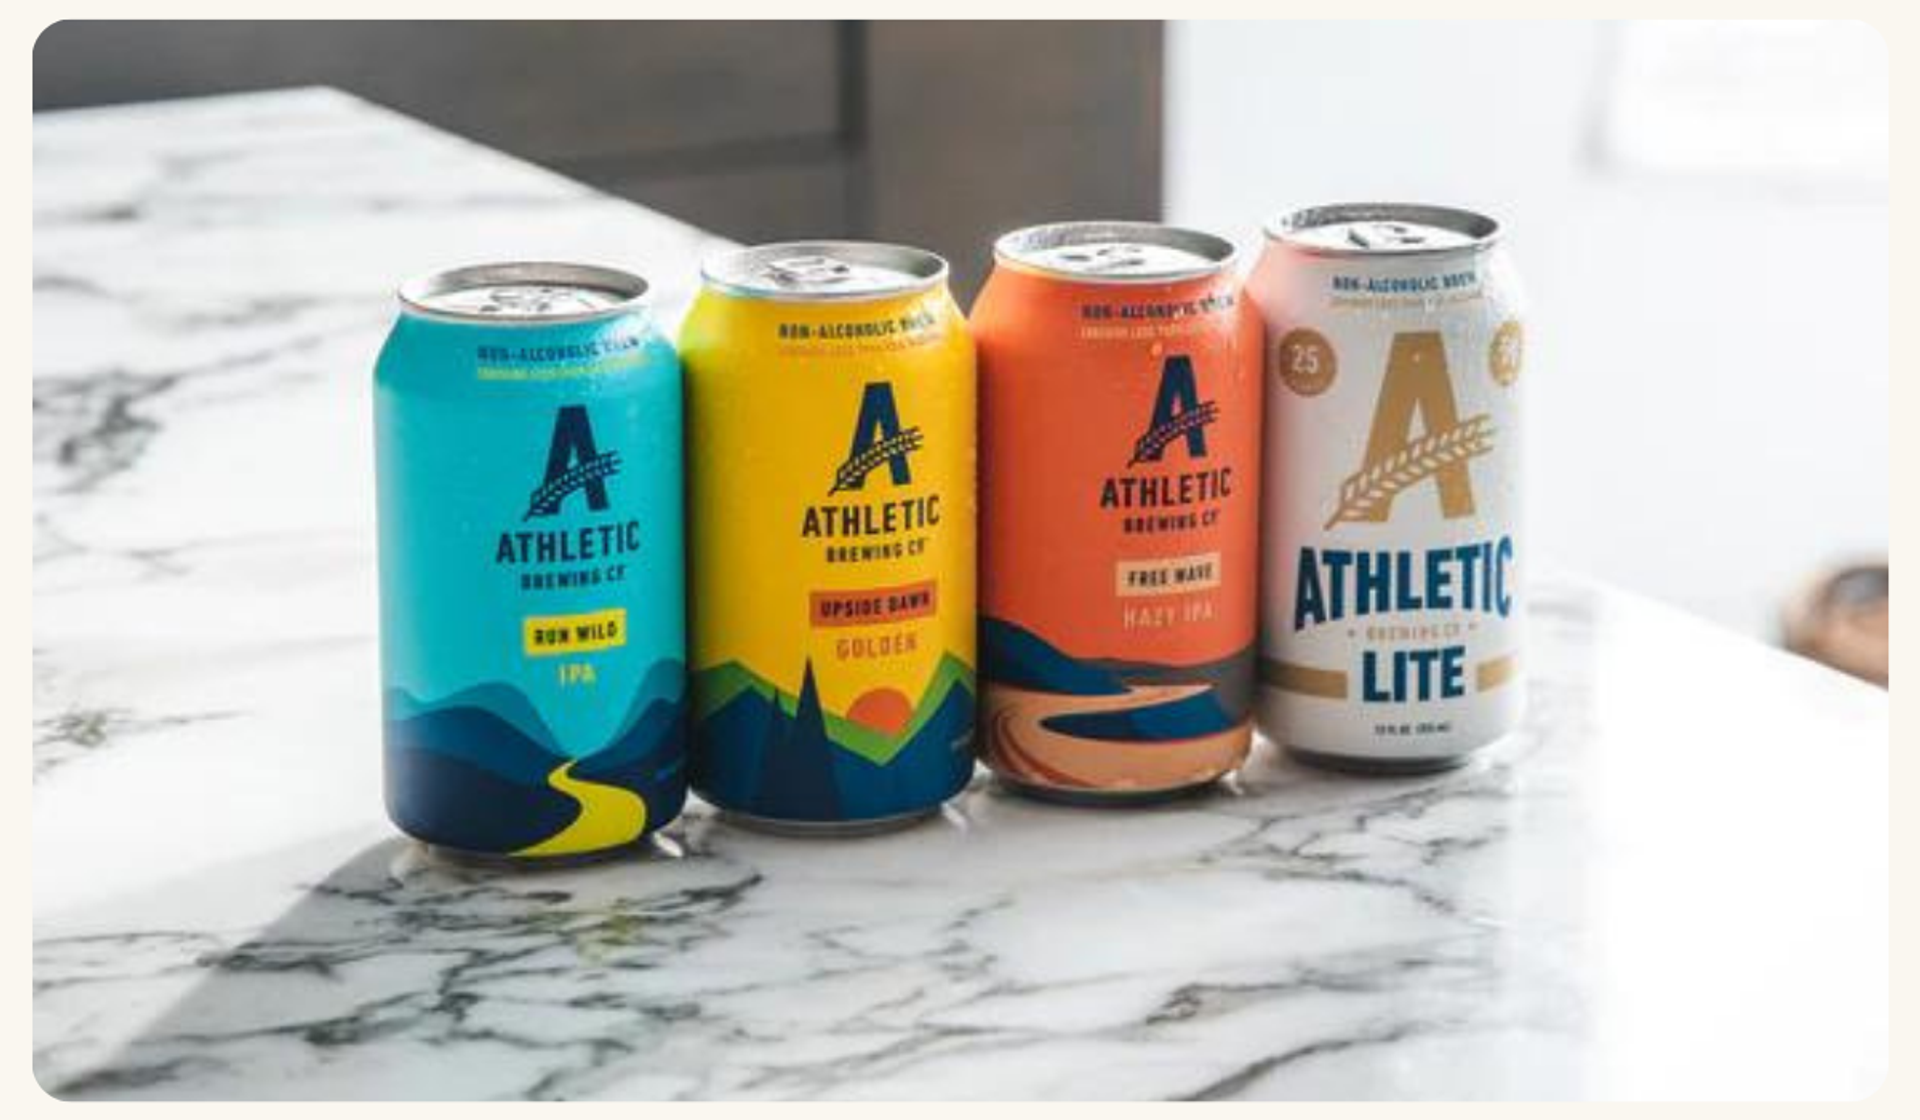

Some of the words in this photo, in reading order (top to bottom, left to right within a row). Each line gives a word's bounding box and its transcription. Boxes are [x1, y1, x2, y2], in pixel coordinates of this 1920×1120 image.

[1292, 344, 1320, 375] 25
[1100, 466, 1231, 508] ATHLETIC
[802, 494, 940, 538] ATHLETIC
[1124, 513, 1197, 533] BREWING
[495, 520, 640, 563] ATHLETIC
[826, 541, 902, 563] BREWING
[521, 567, 601, 590] BREWING
[1129, 569, 1168, 587] FREE
[1173, 562, 1213, 584] WAVE
[1294, 537, 1512, 631] ATHLETIC
[821, 598, 882, 617] UPSIDE
[888, 590, 929, 613] DAWN
[1123, 602, 1175, 631] HAZY
[1183, 599, 1213, 622] IPA
[535, 628, 569, 645] RUN
[576, 621, 617, 641] WILD
[836, 634, 918, 660] GOLDEN
[559, 664, 597, 684] IPA
[1363, 645, 1466, 703] LITE
